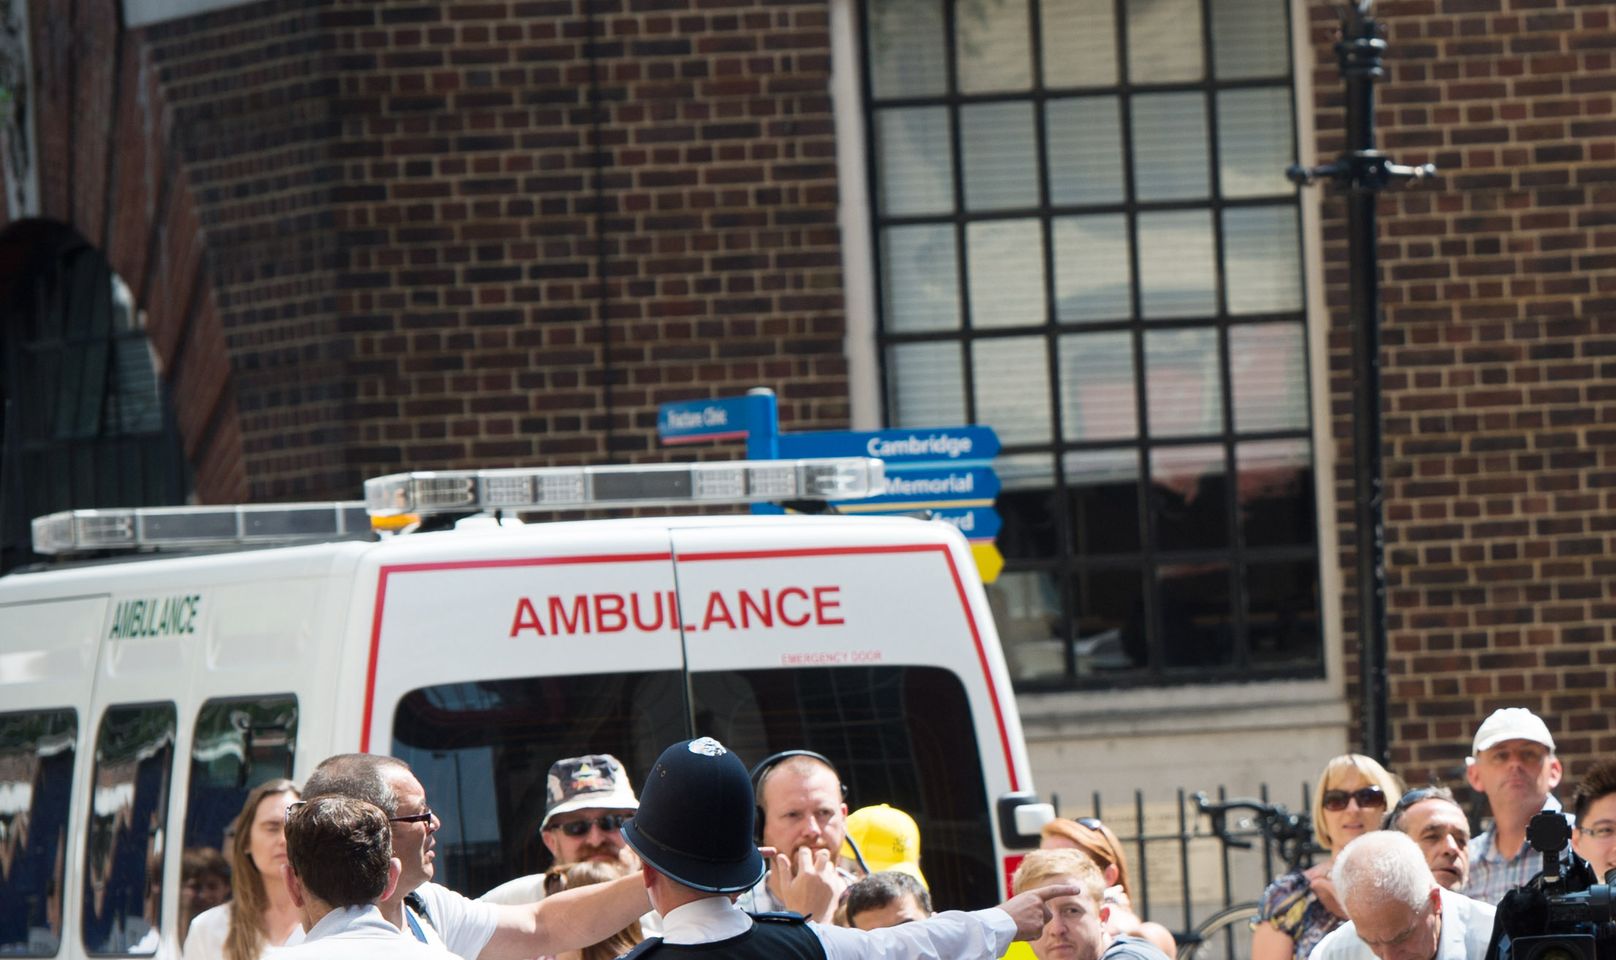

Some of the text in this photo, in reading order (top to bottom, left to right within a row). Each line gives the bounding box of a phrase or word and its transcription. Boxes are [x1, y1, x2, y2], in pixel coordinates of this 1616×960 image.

[866, 434, 973, 458] Cambridge
[109, 595, 200, 639] AMBULANCE
[509, 585, 845, 638] AMBULANCE
[781, 649, 881, 665] EMERGENCY DOOR
